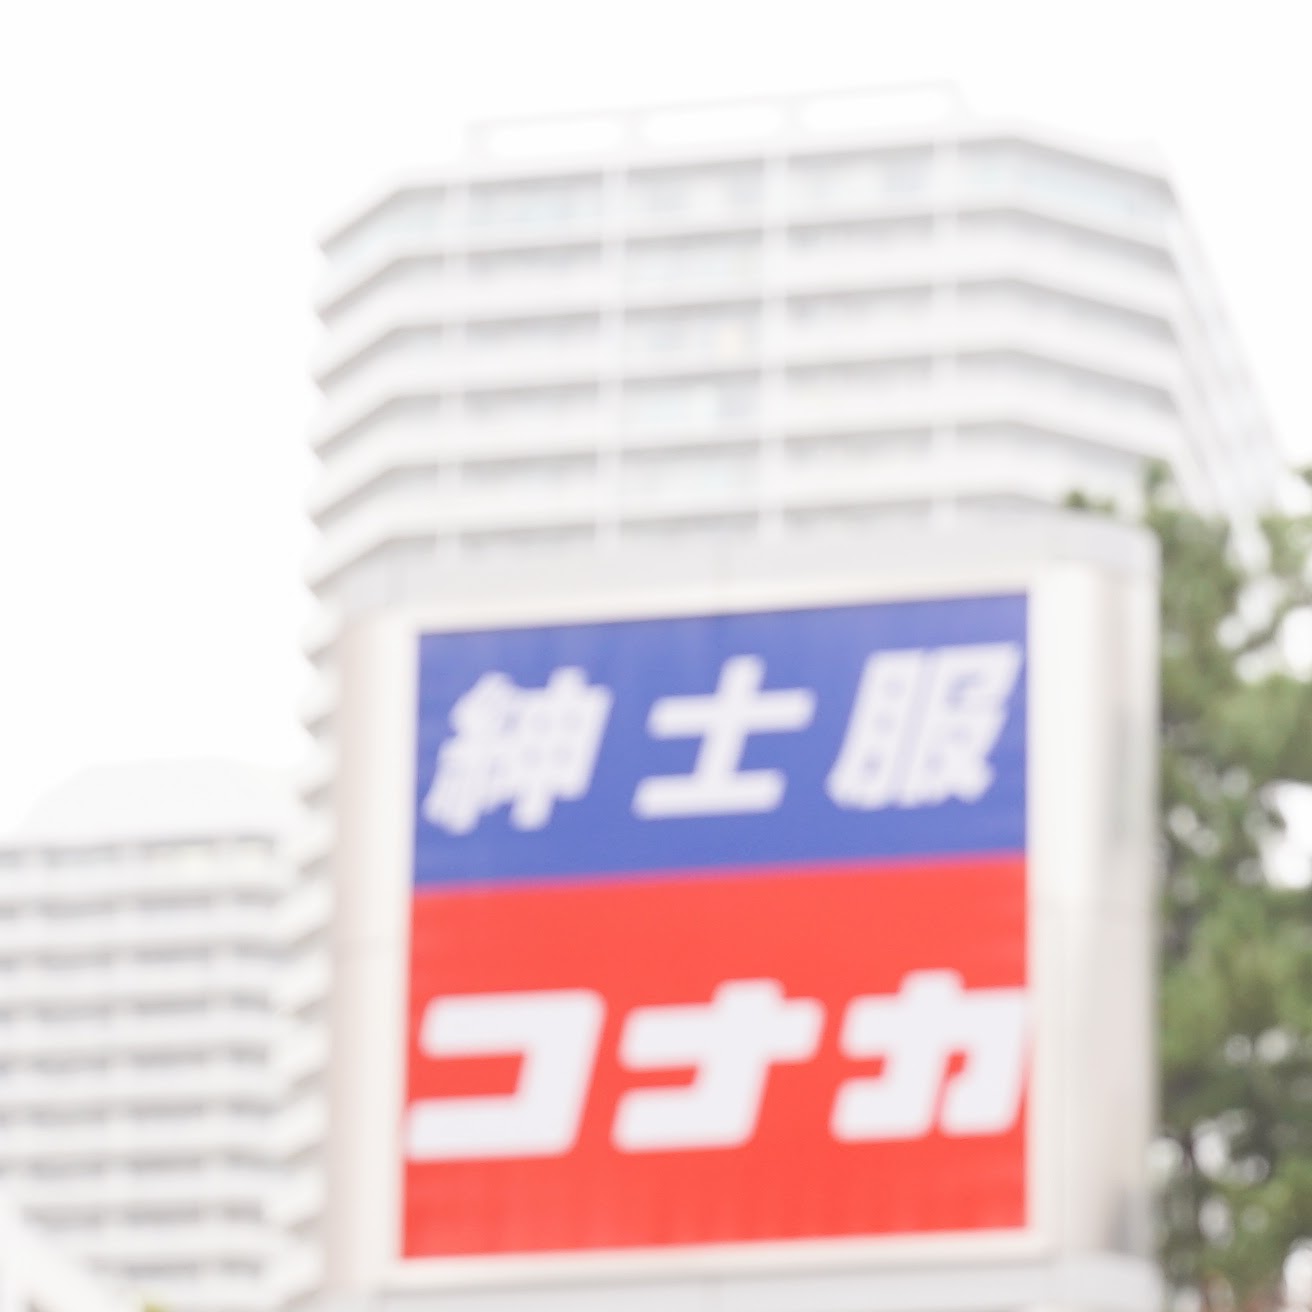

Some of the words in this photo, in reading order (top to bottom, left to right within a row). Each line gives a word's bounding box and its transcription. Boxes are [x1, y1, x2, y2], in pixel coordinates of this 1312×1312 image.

[421, 641, 1023, 835] 紳士服
[404, 967, 1029, 1164] コナカ
